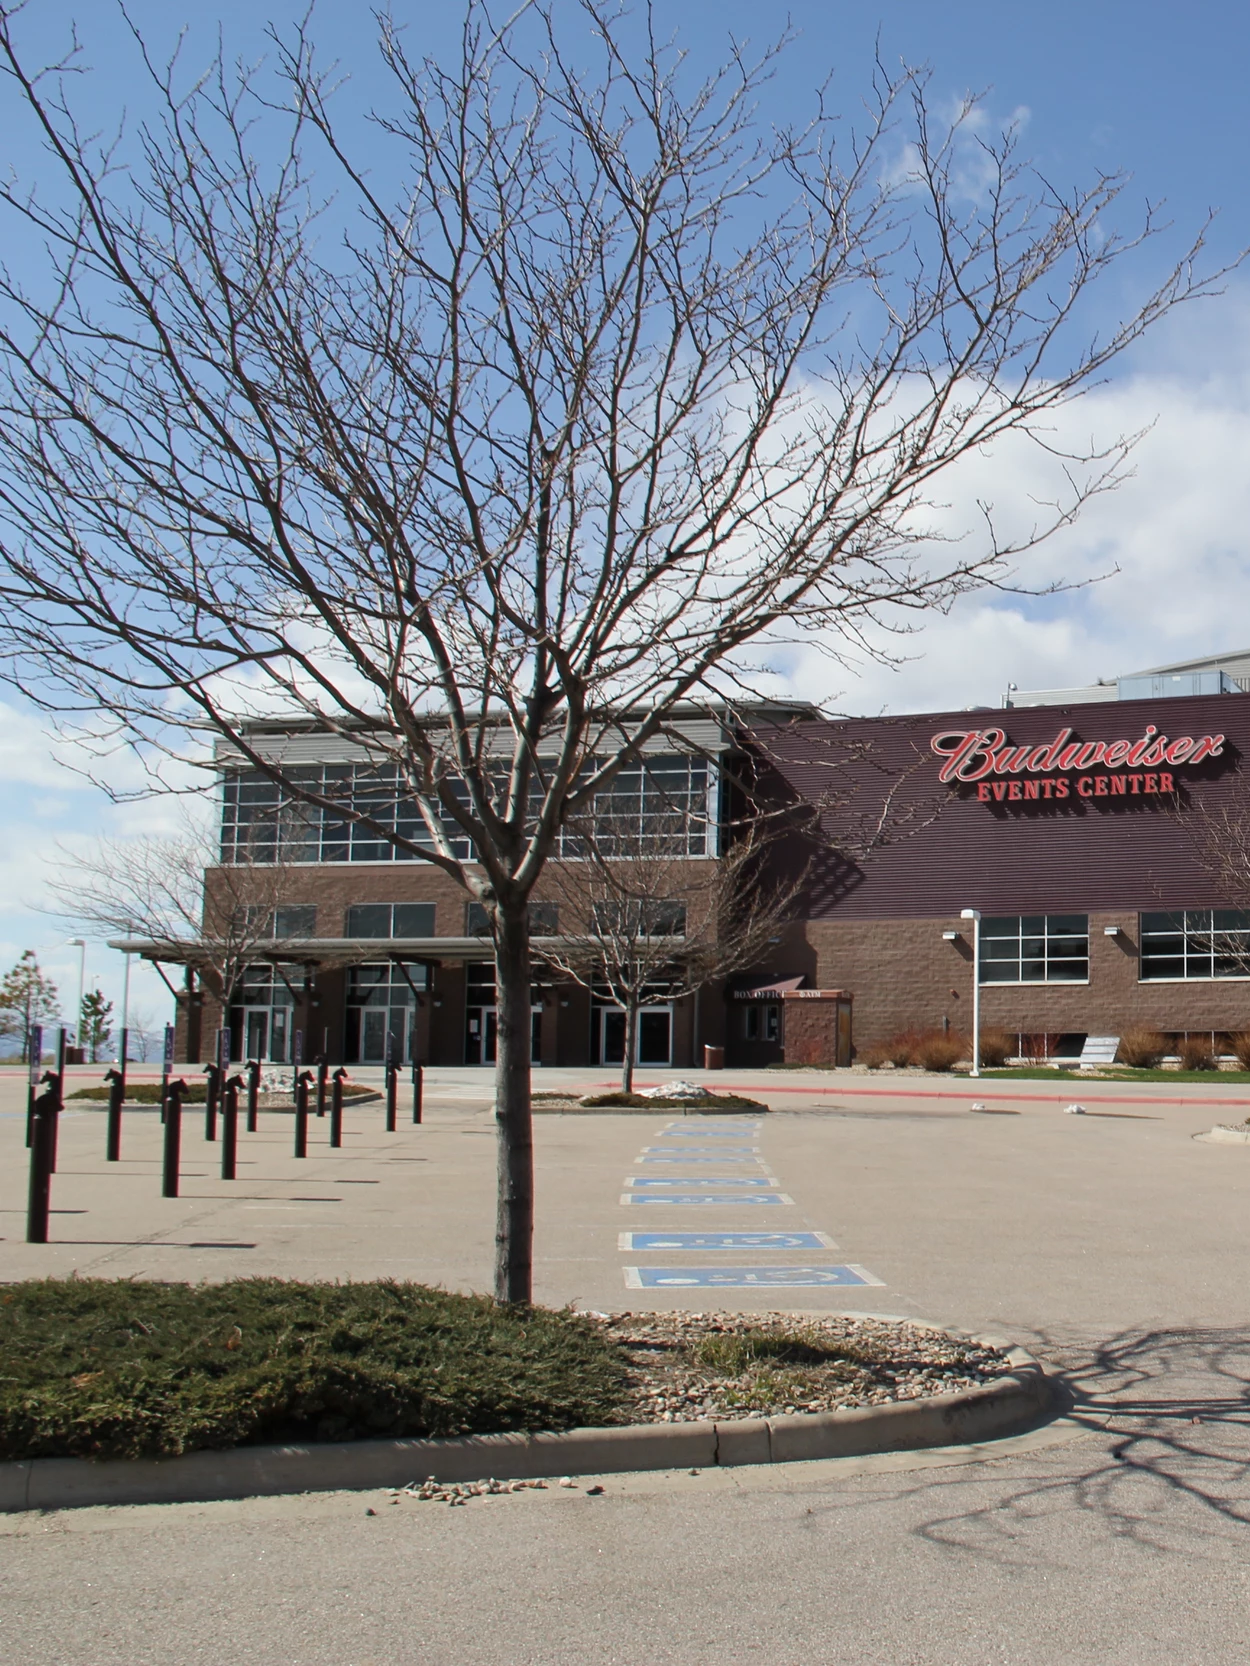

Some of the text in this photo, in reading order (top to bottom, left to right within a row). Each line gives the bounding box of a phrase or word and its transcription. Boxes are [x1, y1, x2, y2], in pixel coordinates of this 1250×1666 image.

[931, 725, 1225, 783] Budweiser
[977, 772, 1174, 801] EVENTS CENTER
[734, 990, 752, 999] BOX
